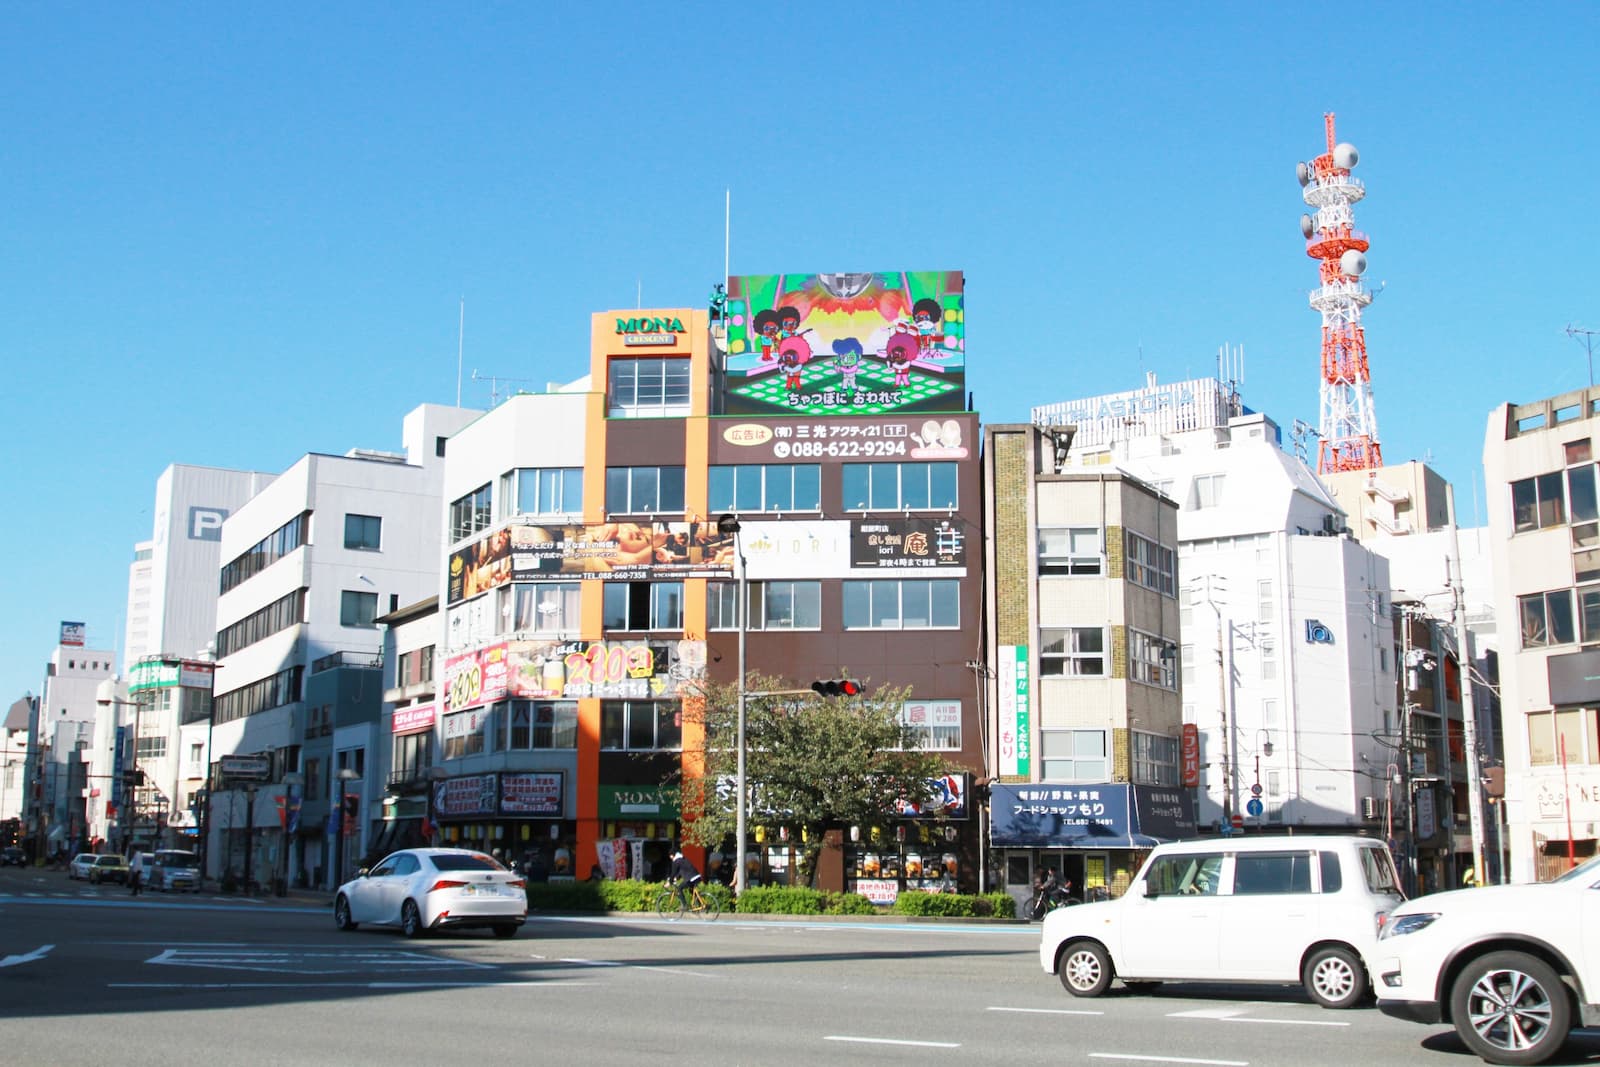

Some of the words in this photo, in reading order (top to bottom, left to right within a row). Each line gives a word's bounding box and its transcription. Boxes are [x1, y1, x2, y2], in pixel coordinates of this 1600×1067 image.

[615, 317, 684, 334] MONA
[627, 335, 671, 344] CRESCENT
[853, 391, 902, 405] おわれて
[731, 428, 766, 441] 広告は
[889, 427, 903, 435] 1F
[792, 441, 906, 457] 088-622-9294
[194, 511, 222, 537] P
[879, 546, 894, 554] iori
[904, 532, 929, 555] 庵
[1002, 730, 1014, 759] もり
[614, 791, 665, 804] MONA
[1014, 805, 1077, 815] フードショップ
[1079, 803, 1105, 816] もり
